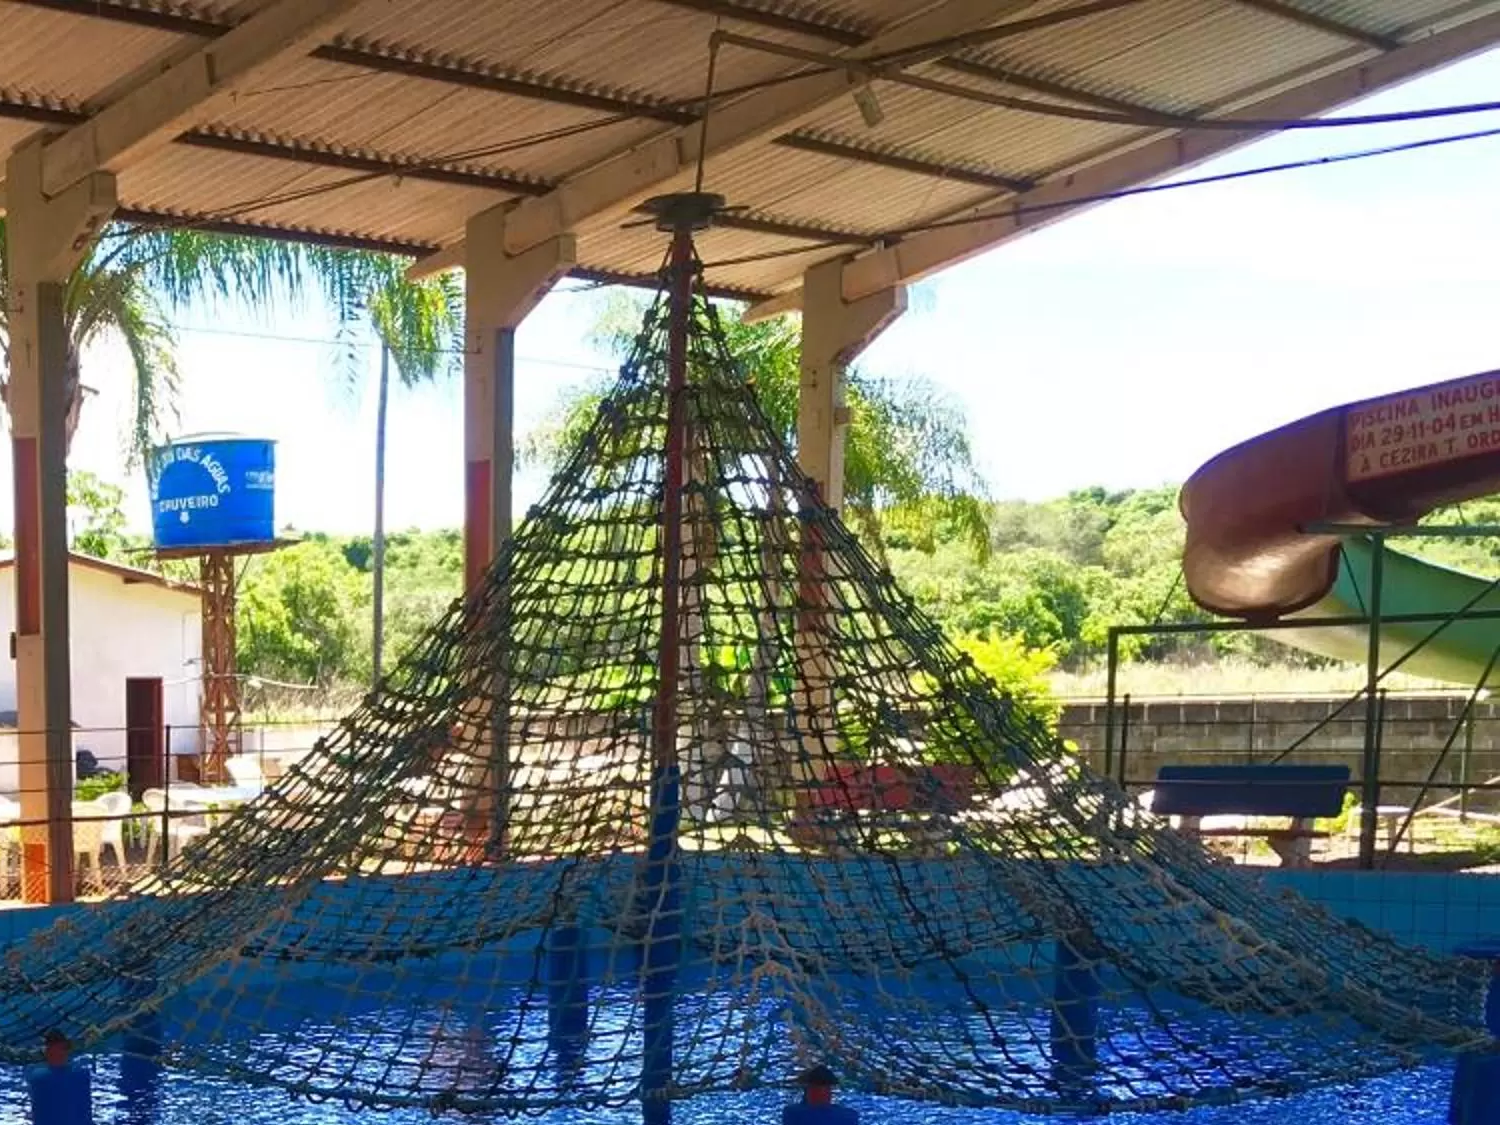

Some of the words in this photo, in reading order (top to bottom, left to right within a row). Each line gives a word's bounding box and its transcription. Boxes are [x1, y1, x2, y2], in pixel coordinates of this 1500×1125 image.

[1348, 398, 1420, 431] PISCINA
[1350, 431, 1376, 452] DIA
[1459, 411, 1483, 430] EM
[175, 447, 202, 463] DAS
